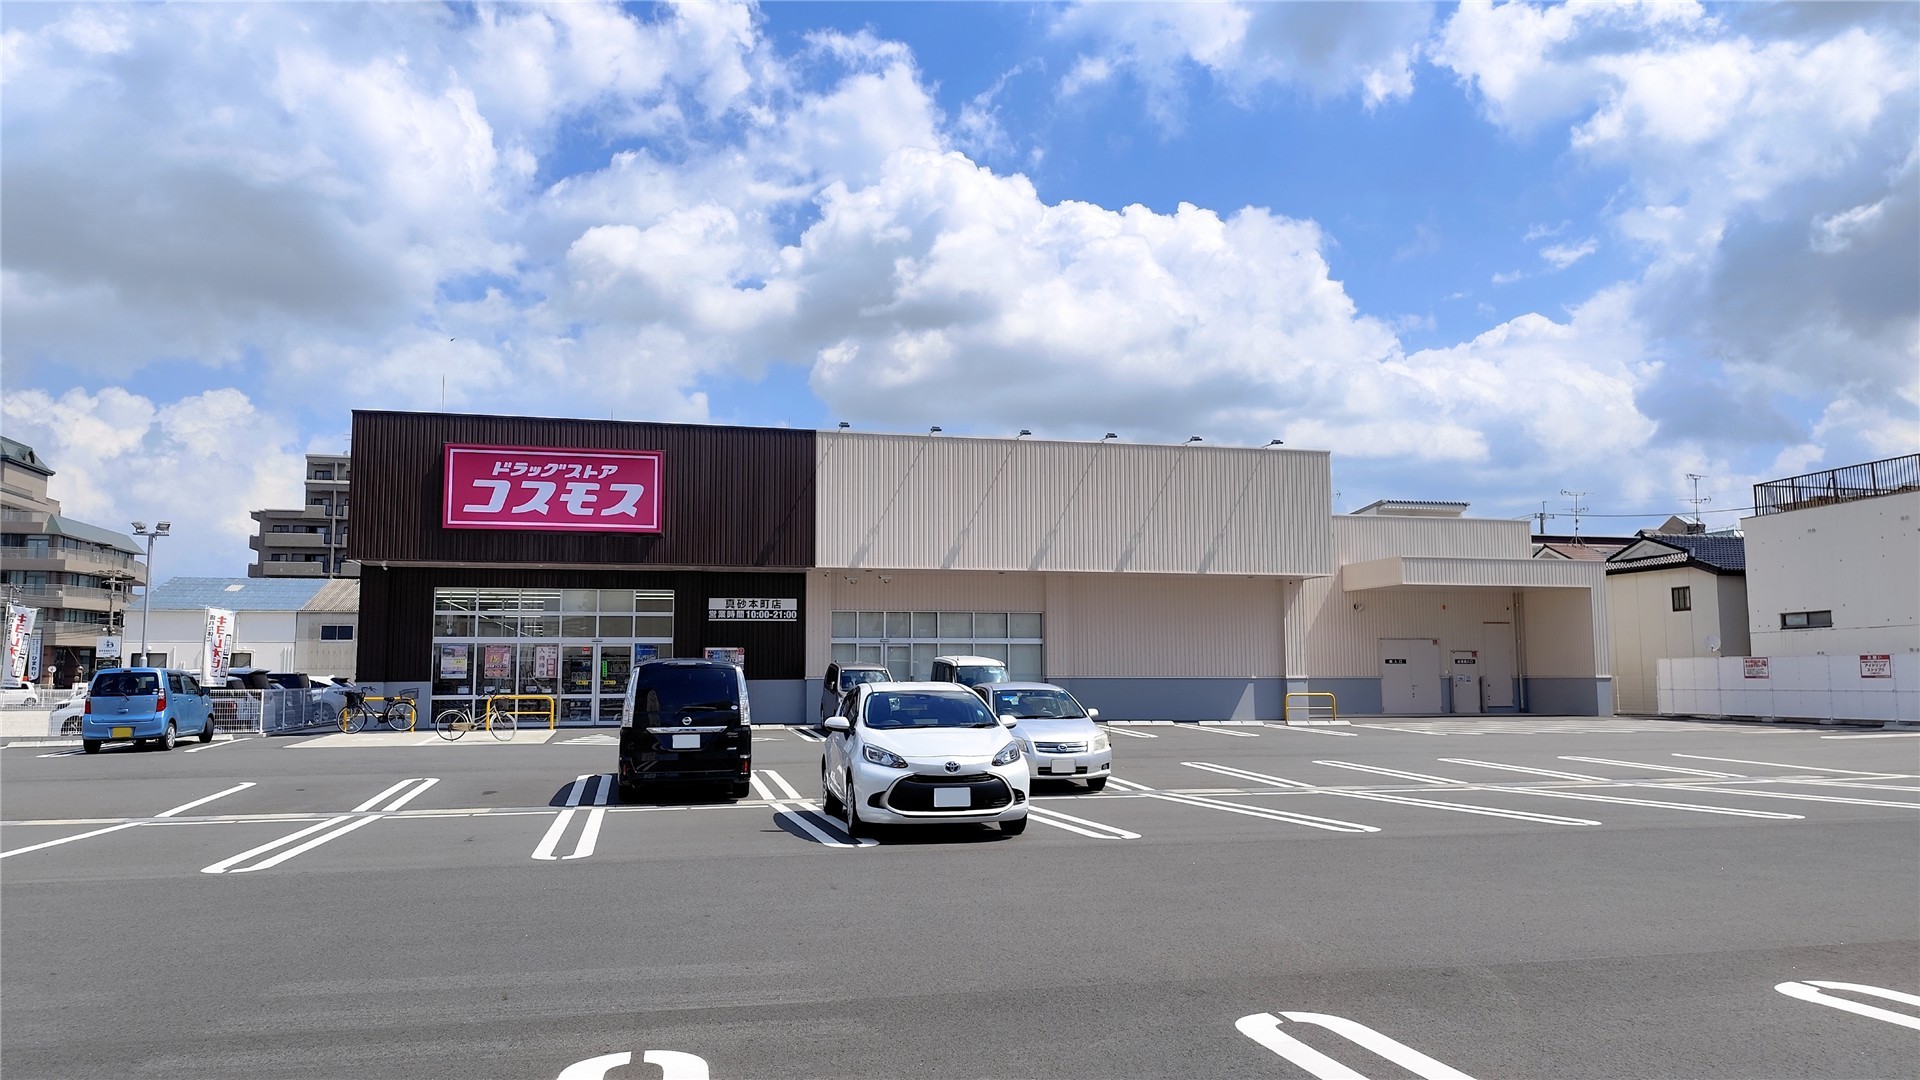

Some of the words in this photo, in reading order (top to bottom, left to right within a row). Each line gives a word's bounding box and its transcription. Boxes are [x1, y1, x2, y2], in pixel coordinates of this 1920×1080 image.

[492, 461, 619, 479] ドラッグストア
[463, 479, 645, 518] コスモス
[725, 599, 781, 609] 真砂本町店
